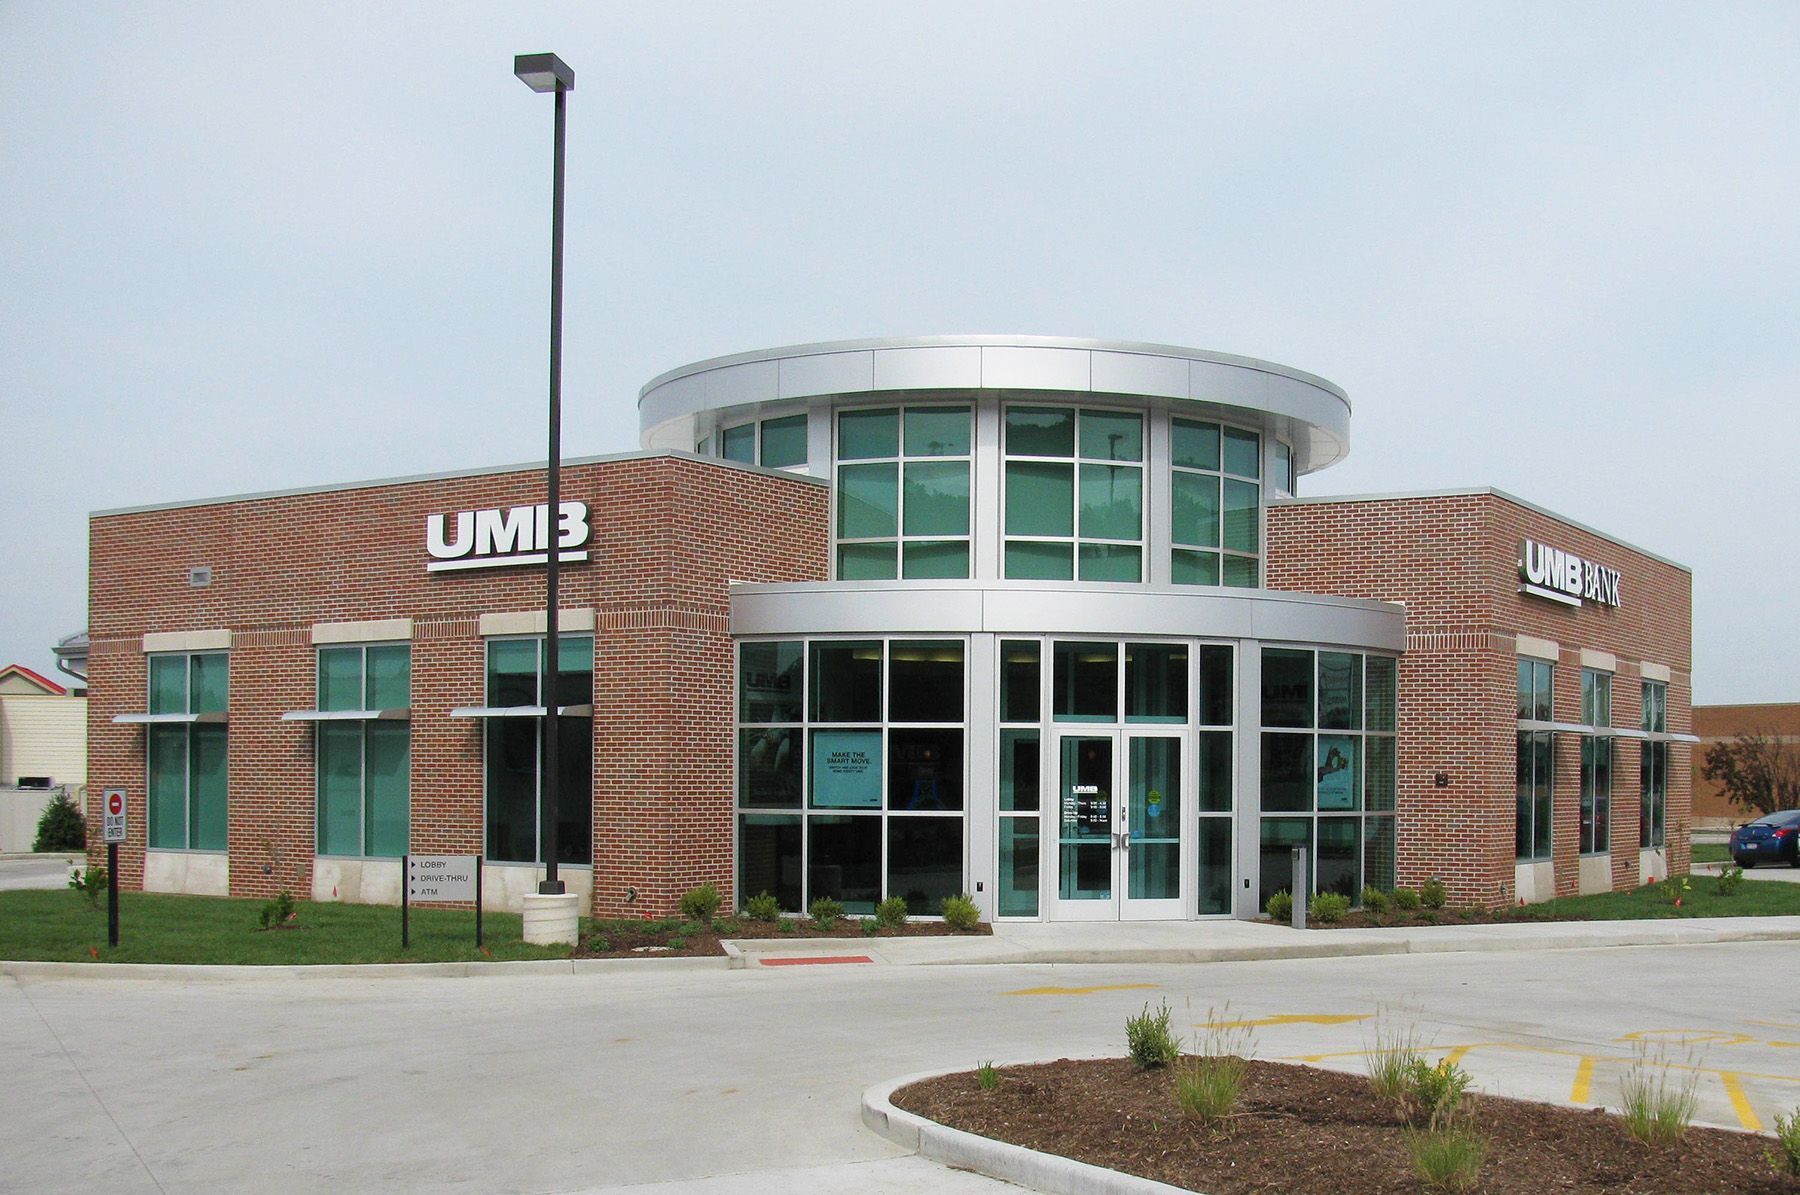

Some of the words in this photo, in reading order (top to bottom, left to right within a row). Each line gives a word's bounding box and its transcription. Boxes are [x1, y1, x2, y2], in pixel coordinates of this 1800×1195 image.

[427, 501, 589, 559] UMB
[1526, 540, 1583, 596] UMB
[1584, 561, 1621, 607] BANK
[1072, 785, 1098, 793] UMB
[107, 816, 114, 826] DO
[114, 816, 124, 826] NOT
[108, 827, 122, 838] ENTER
